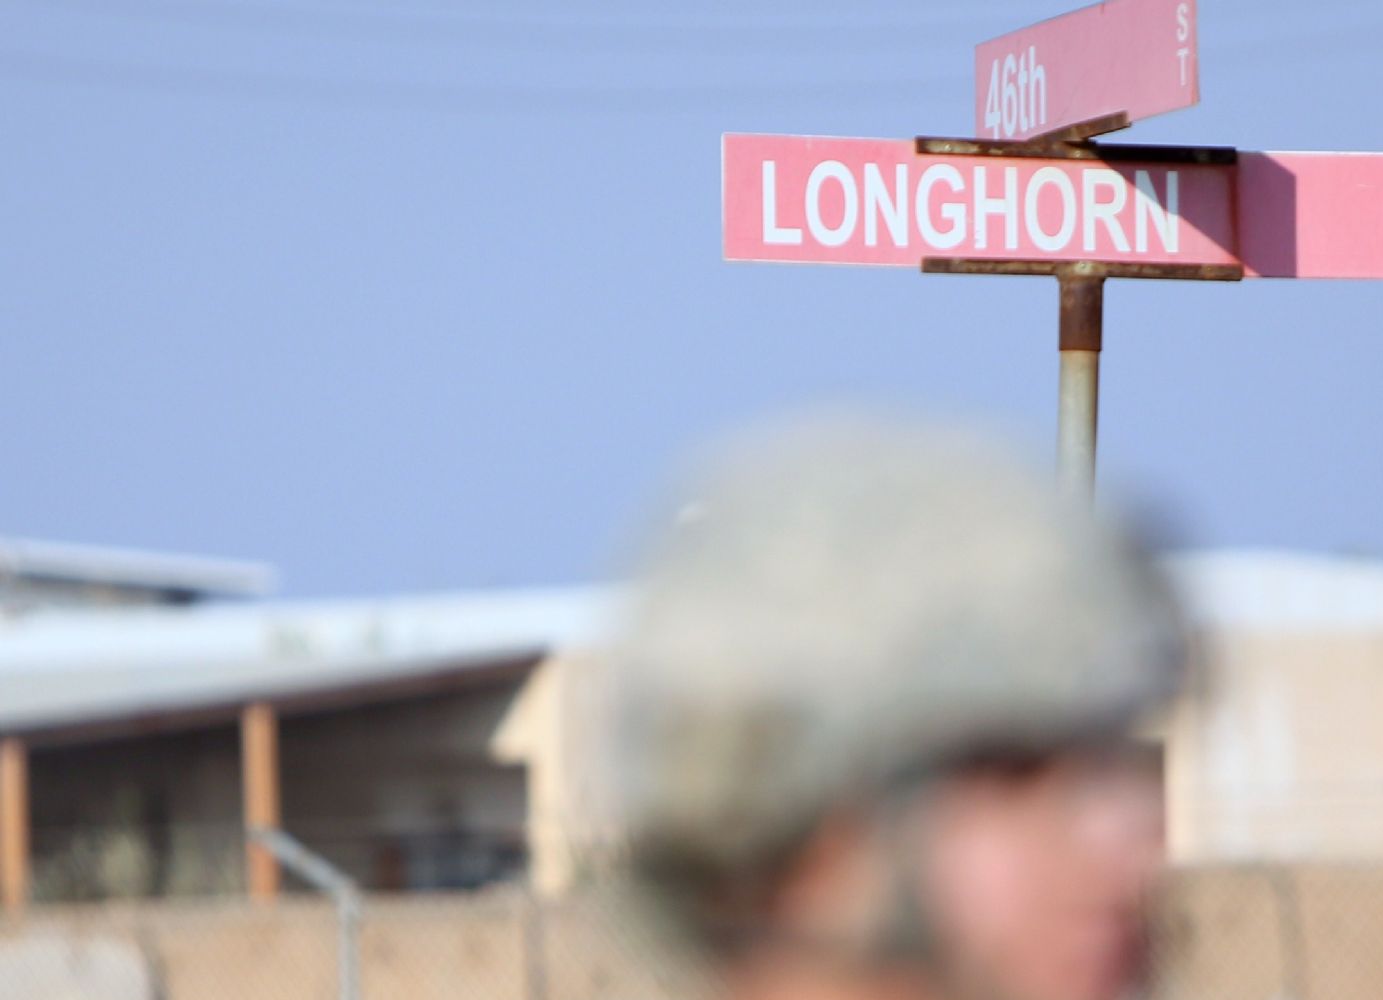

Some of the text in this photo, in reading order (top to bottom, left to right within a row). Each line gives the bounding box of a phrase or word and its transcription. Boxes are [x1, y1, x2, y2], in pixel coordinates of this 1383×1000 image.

[984, 3, 1189, 140] 46th ST
[762, 159, 1179, 253] LONGHORN
